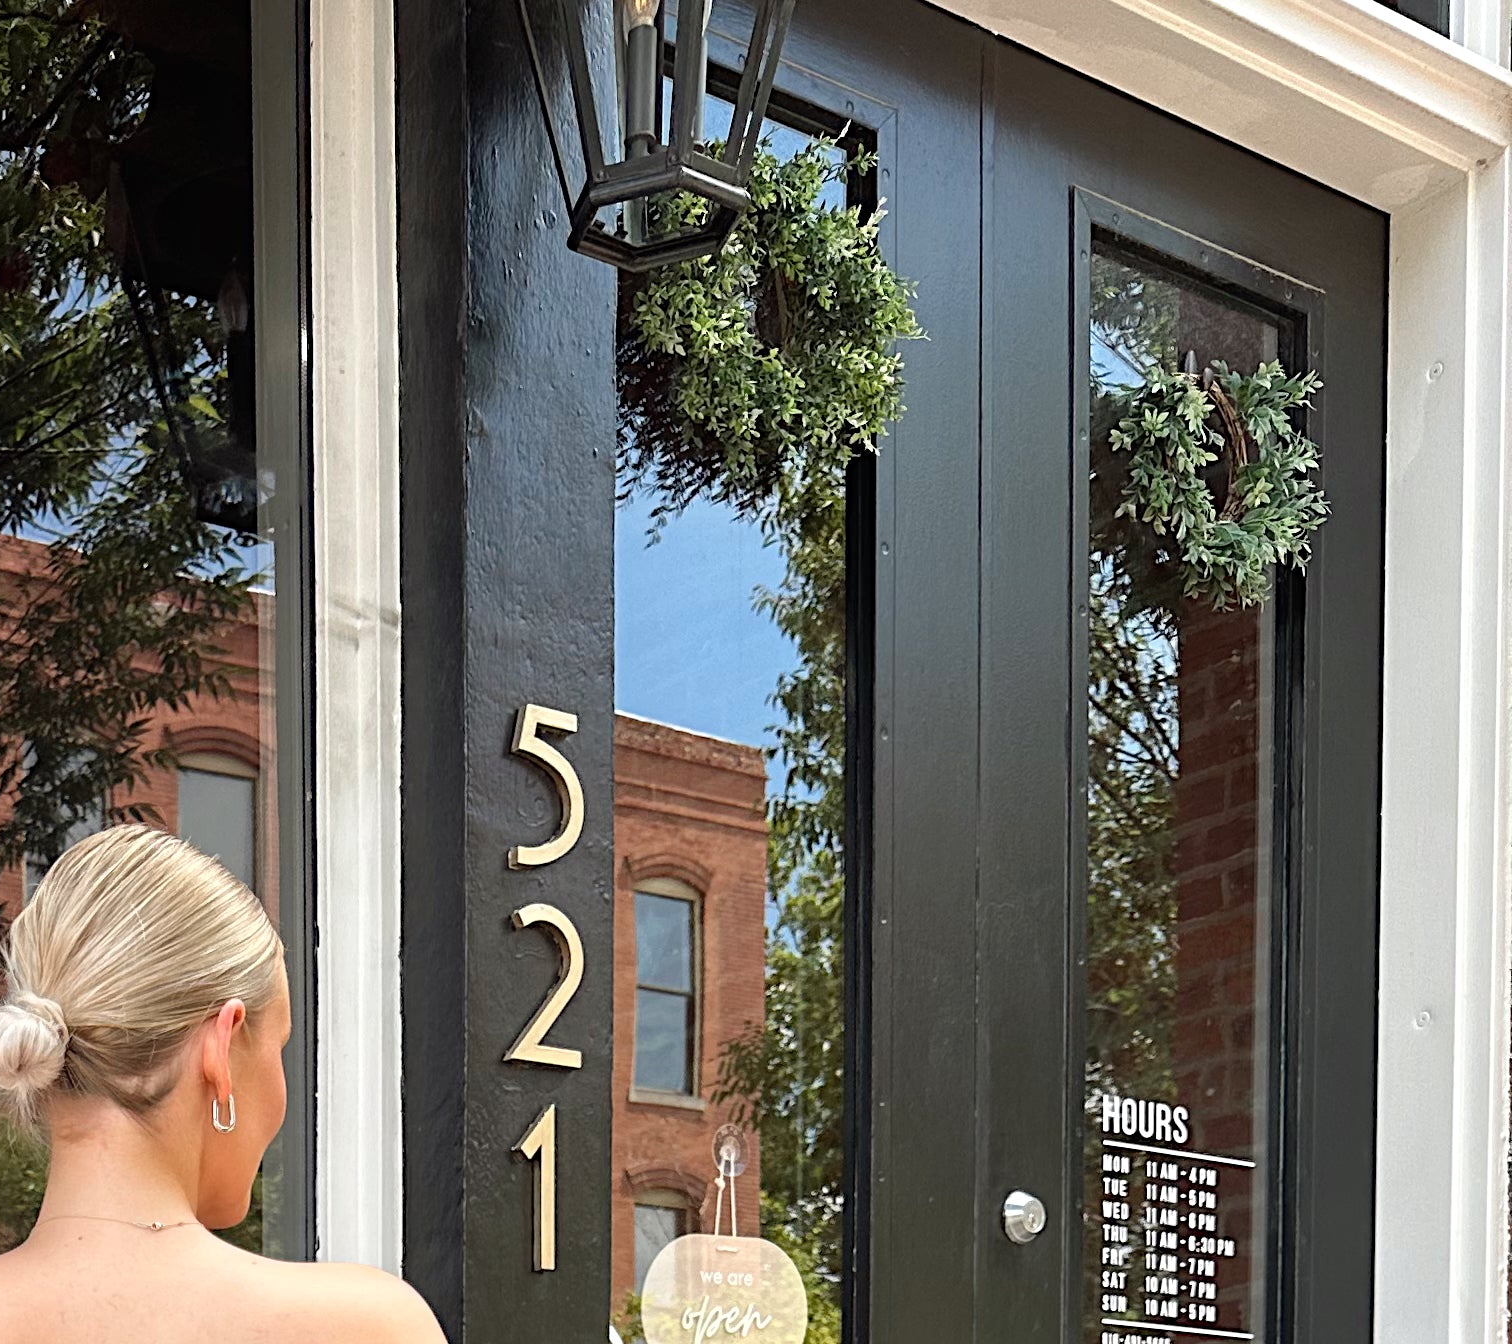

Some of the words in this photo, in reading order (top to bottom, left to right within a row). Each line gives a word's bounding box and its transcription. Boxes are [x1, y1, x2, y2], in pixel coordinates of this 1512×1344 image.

[502, 703, 585, 1272] 521
[1102, 1094, 1188, 1143] HOURS
[1103, 1154, 1129, 1173] MON
[1147, 1161, 1156, 1177] 11
[1160, 1163, 1177, 1180] AM
[1189, 1168, 1197, 1183] 4
[1199, 1169, 1216, 1186] PM
[1103, 1178, 1127, 1196] TUE
[1146, 1184, 1156, 1200] 11
[1160, 1186, 1177, 1203] AM
[1189, 1190, 1196, 1206] 5
[1199, 1191, 1215, 1208] PM
[1103, 1201, 1128, 1219] WED
[1145, 1207, 1156, 1225] 11
[1160, 1209, 1177, 1226] AM
[1189, 1213, 1196, 1228] 6
[1199, 1214, 1215, 1231] PM
[1103, 1224, 1127, 1242] THU
[1146, 1230, 1156, 1246] 11
[1160, 1232, 1177, 1249] AM
[1189, 1236, 1214, 1253] 6:30
[1217, 1239, 1234, 1256] PM
[1103, 1246, 1126, 1266] FRI
[1146, 1254, 1156, 1269] 11
[1160, 1255, 1177, 1272] AM
[1188, 1258, 1195, 1274] 7
[1198, 1259, 1214, 1276] PM
[699, 1270, 723, 1285] we
[727, 1272, 754, 1286] are
[1103, 1271, 1126, 1288] SAT
[1146, 1276, 1158, 1292] 10
[1160, 1278, 1178, 1295] AM
[1189, 1281, 1196, 1297] 7
[1199, 1282, 1215, 1299] PM
[1102, 1295, 1126, 1312] SUN
[1146, 1299, 1158, 1315] 10
[1160, 1301, 1177, 1317] AM
[1189, 1304, 1196, 1319] 5
[1199, 1305, 1215, 1321] PM
